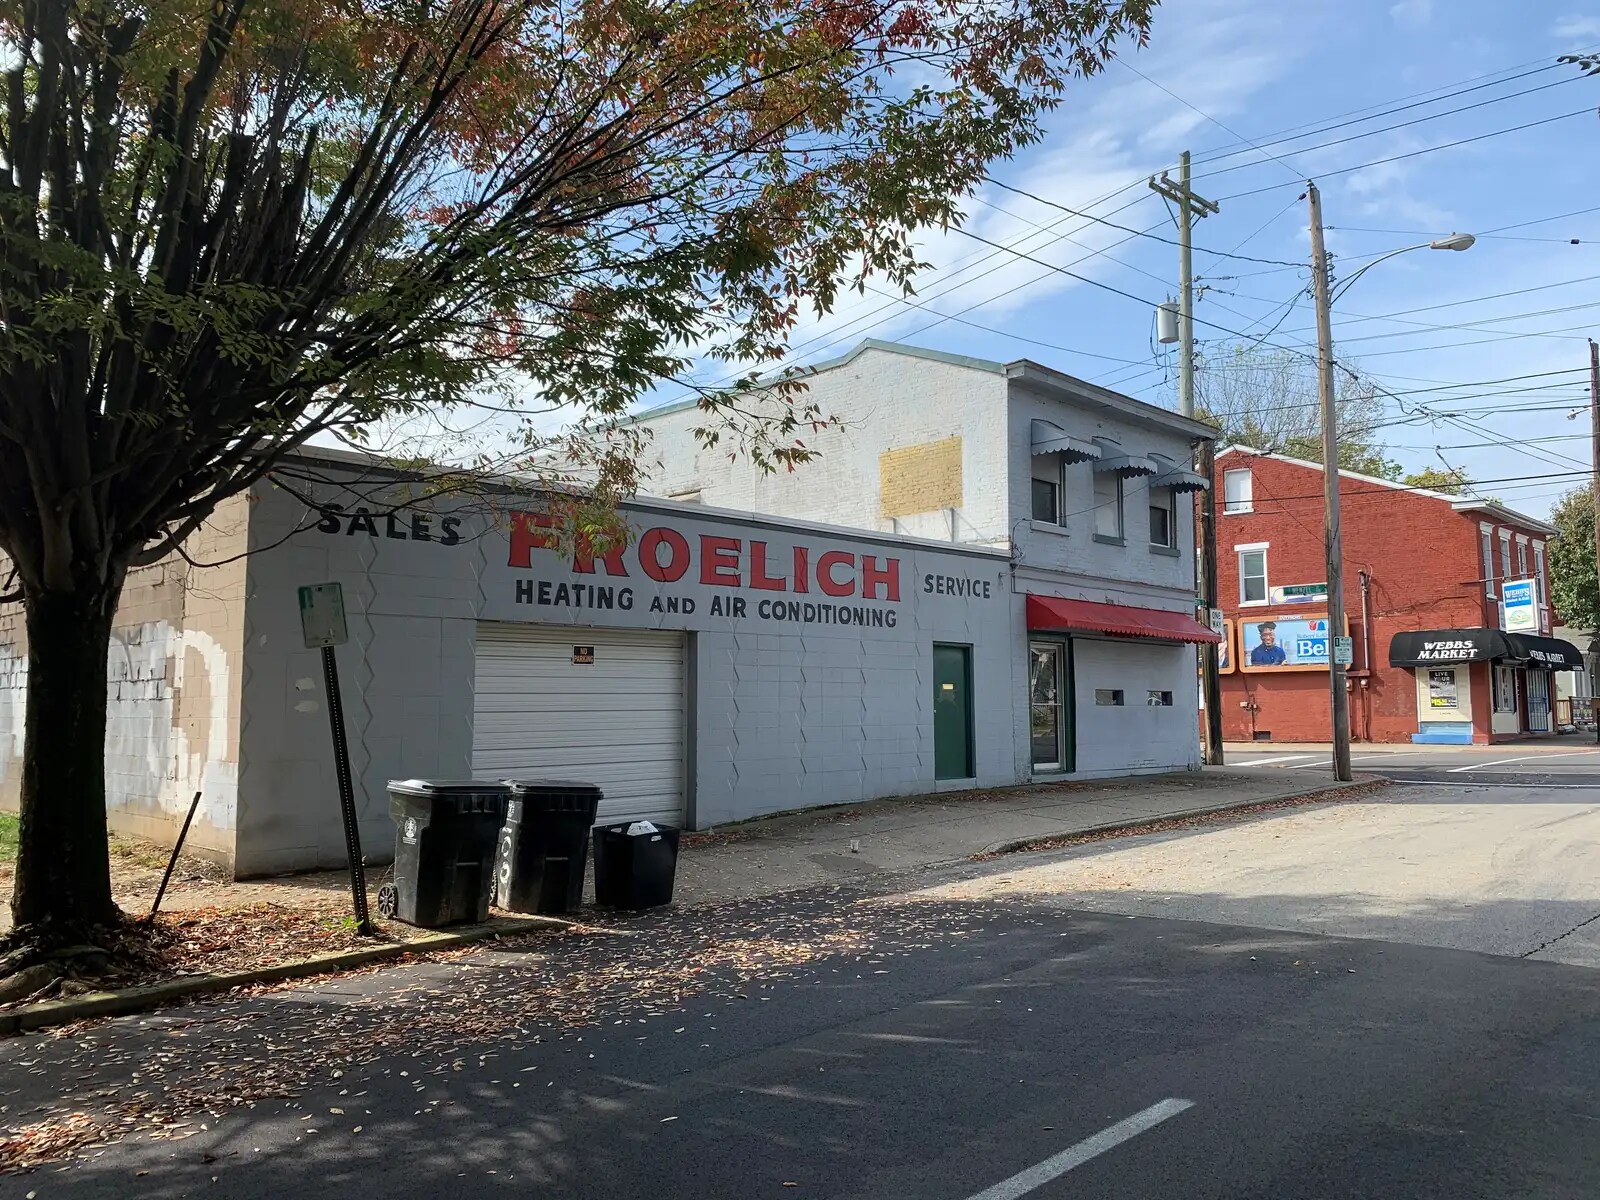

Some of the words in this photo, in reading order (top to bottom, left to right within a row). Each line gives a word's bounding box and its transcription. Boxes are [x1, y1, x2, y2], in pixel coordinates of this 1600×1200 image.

[317, 503, 461, 546] SALES
[508, 510, 901, 602] FROELICH
[923, 573, 991, 599] SERVICE
[515, 580, 634, 611] HEATING
[649, 595, 696, 615] AND
[709, 595, 747, 618] AIR
[757, 599, 898, 629] CONDITIONING
[1212, 611, 1221, 620] ONE
[580, 647, 588, 655] NO
[1297, 640, 1330, 656] Bel
[1423, 640, 1474, 650] WEBBS
[574, 655, 594, 663] PARKING
[1417, 648, 1479, 660] MARKET
